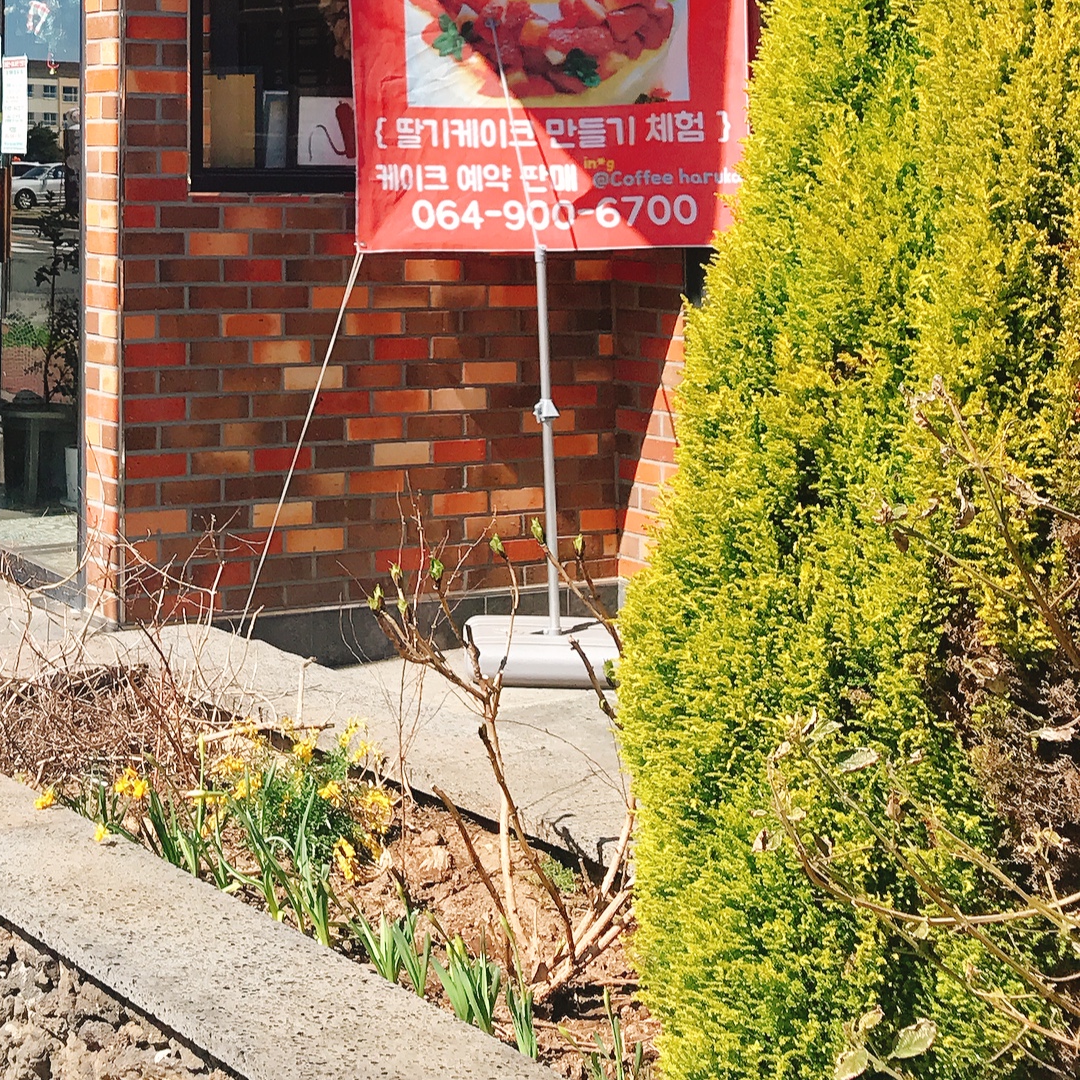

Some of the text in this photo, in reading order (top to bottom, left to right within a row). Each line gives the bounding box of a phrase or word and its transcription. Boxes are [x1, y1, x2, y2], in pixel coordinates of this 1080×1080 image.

[396, 117, 538, 149] 딸기케이크
[545, 115, 636, 149] 만들기
[645, 110, 705, 144] 체험
[375, 163, 579, 193] 케이크 예약 판매
[593, 169, 674, 189] @Coffee
[411, 193, 698, 231] 064-900-6700
